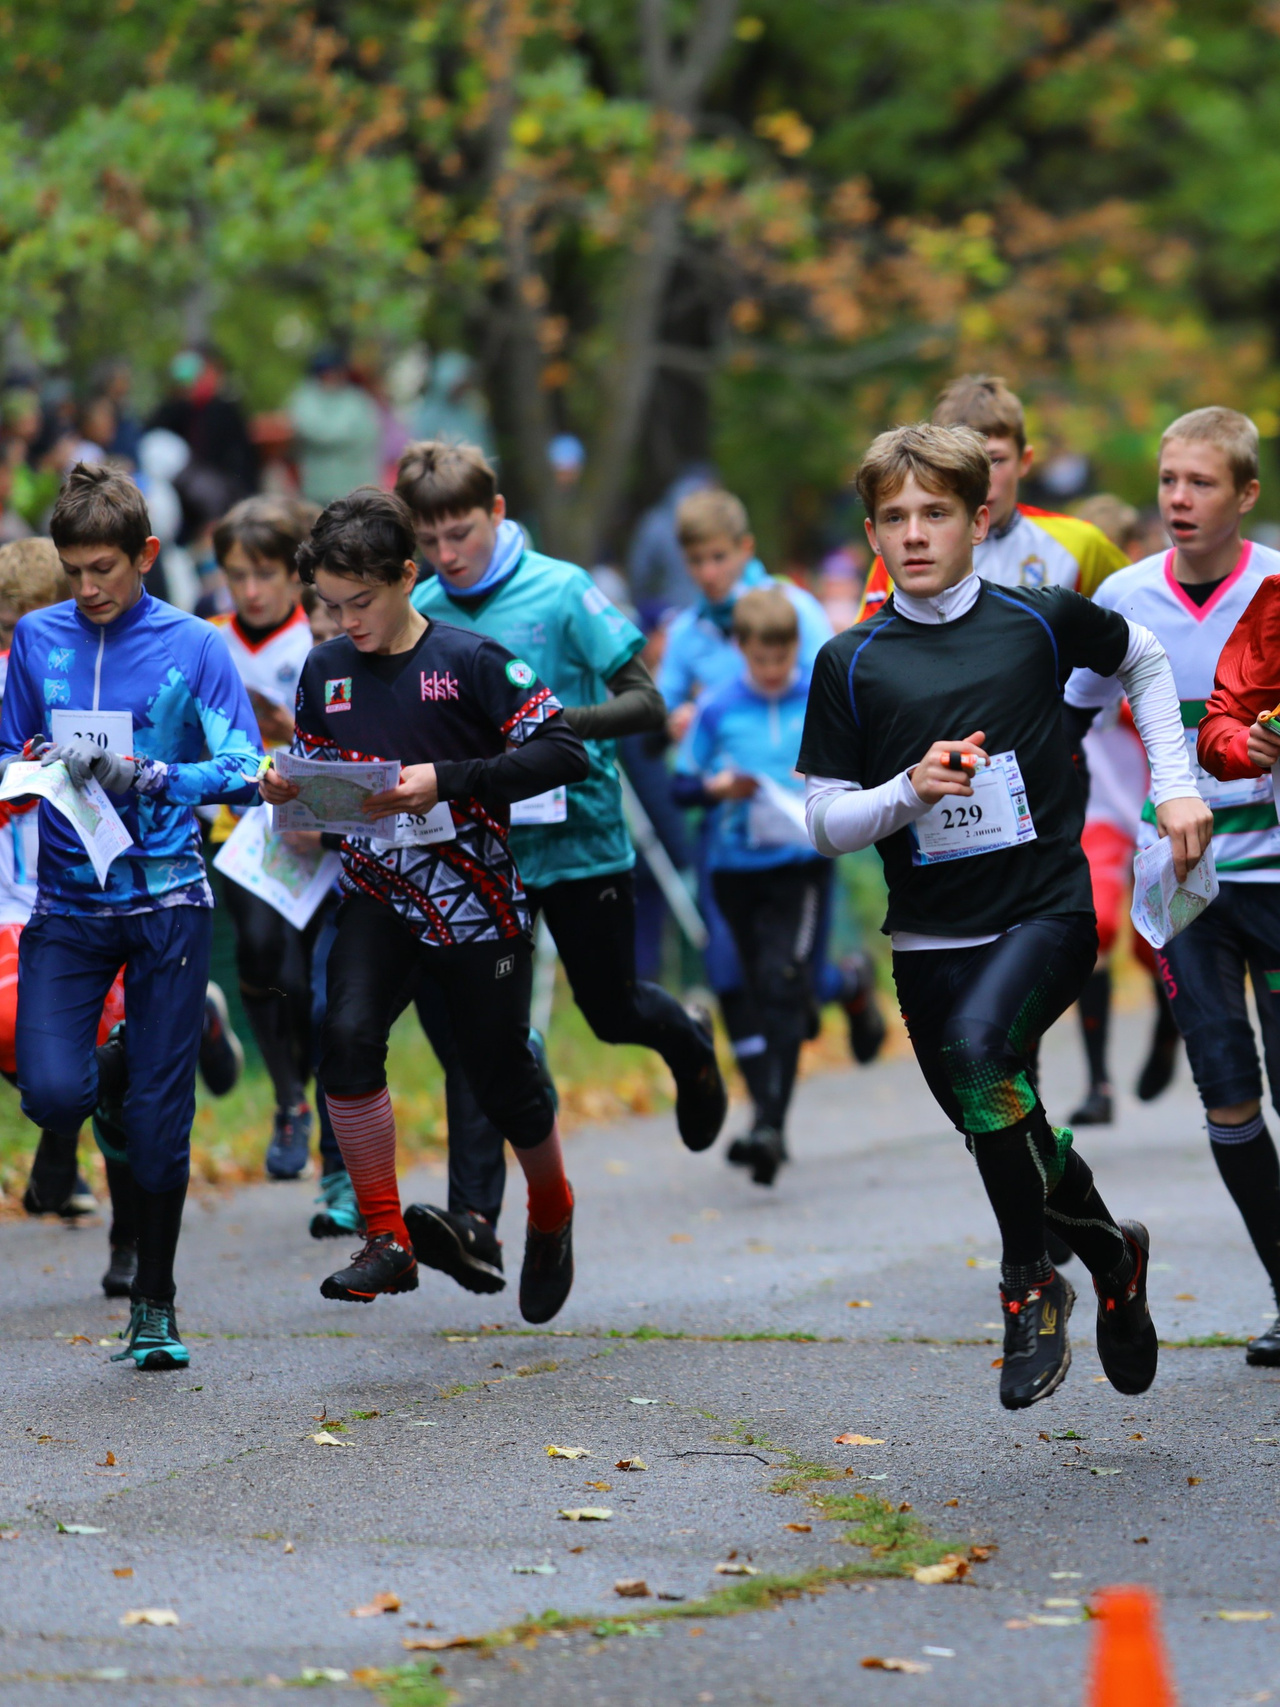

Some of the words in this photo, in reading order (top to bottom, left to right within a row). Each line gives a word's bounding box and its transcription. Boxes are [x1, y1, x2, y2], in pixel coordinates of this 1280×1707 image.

[941, 804, 983, 830] 229
[965, 830, 971, 838] 2
[973, 826, 1002, 837] линия
